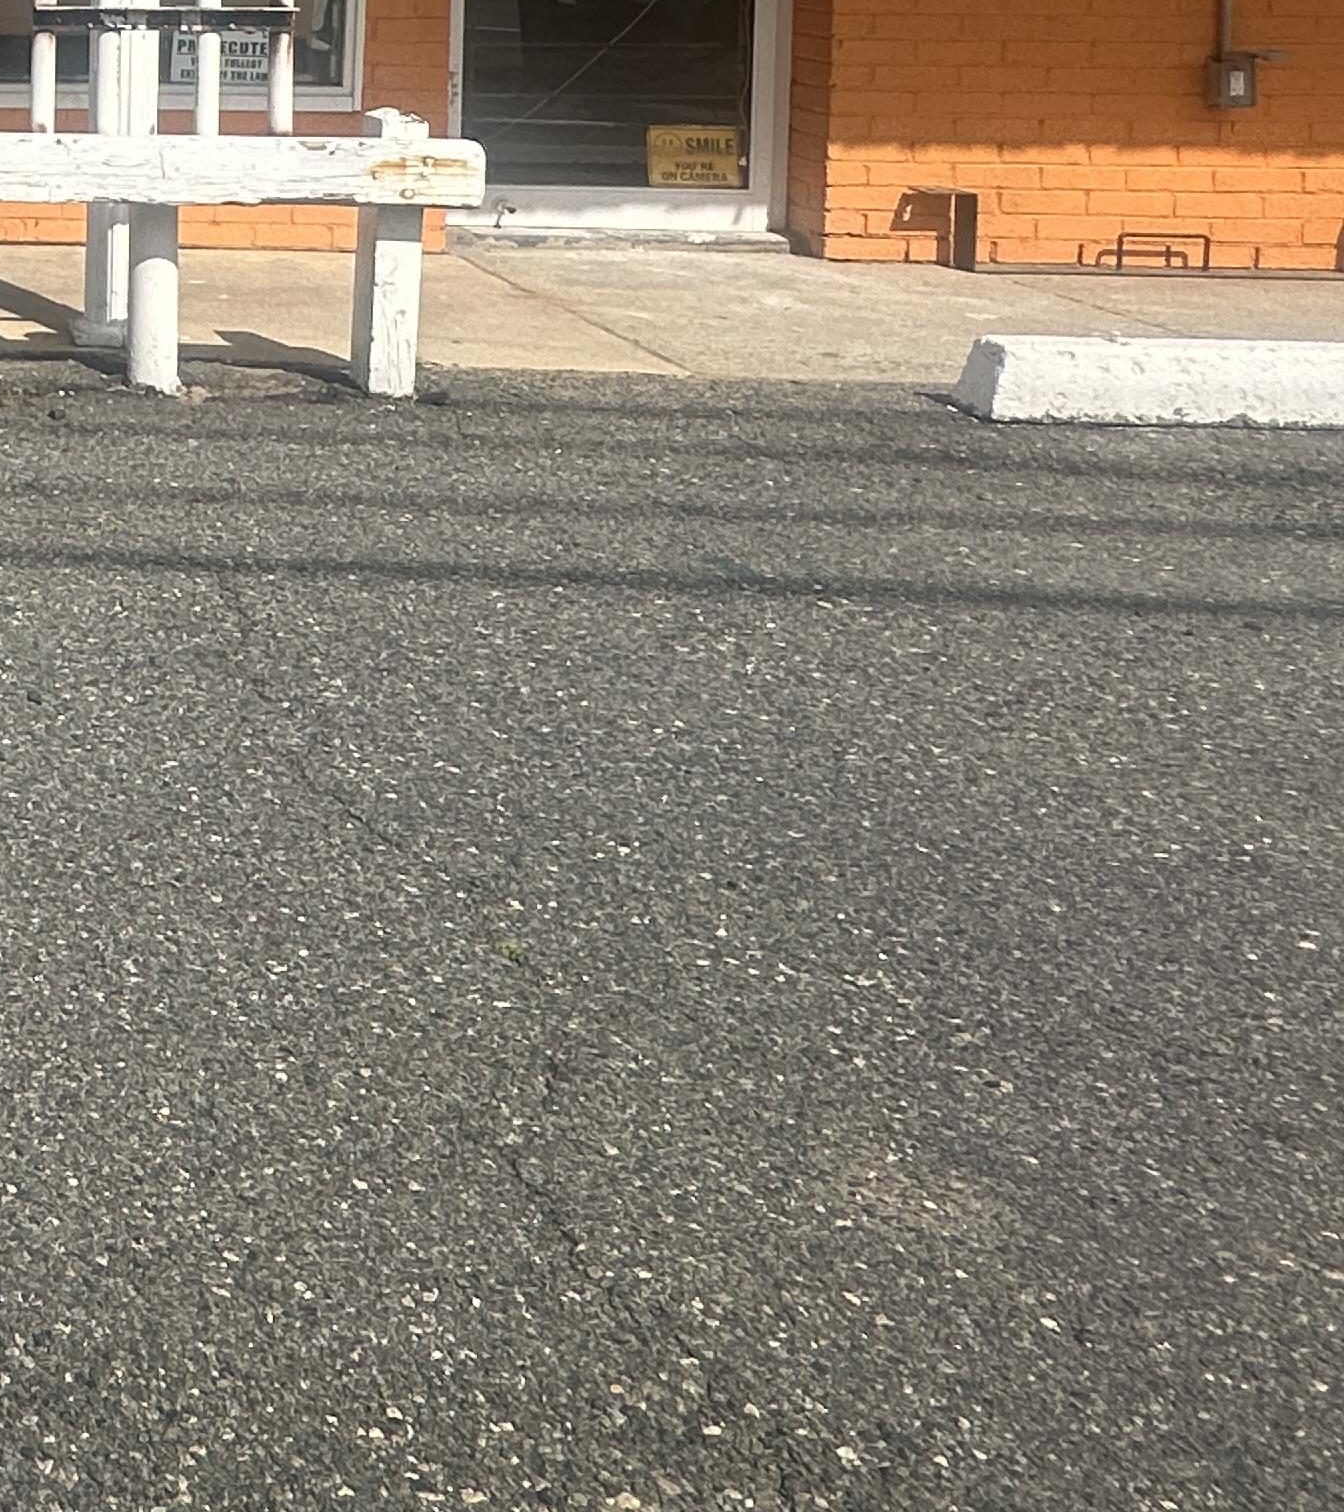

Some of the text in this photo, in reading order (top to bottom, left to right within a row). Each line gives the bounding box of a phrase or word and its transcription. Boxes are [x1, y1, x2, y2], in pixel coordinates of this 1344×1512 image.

[177, 39, 268, 56] PRECUTE
[685, 137, 735, 156] SMILE
[661, 172, 728, 182] ON CAMERA
